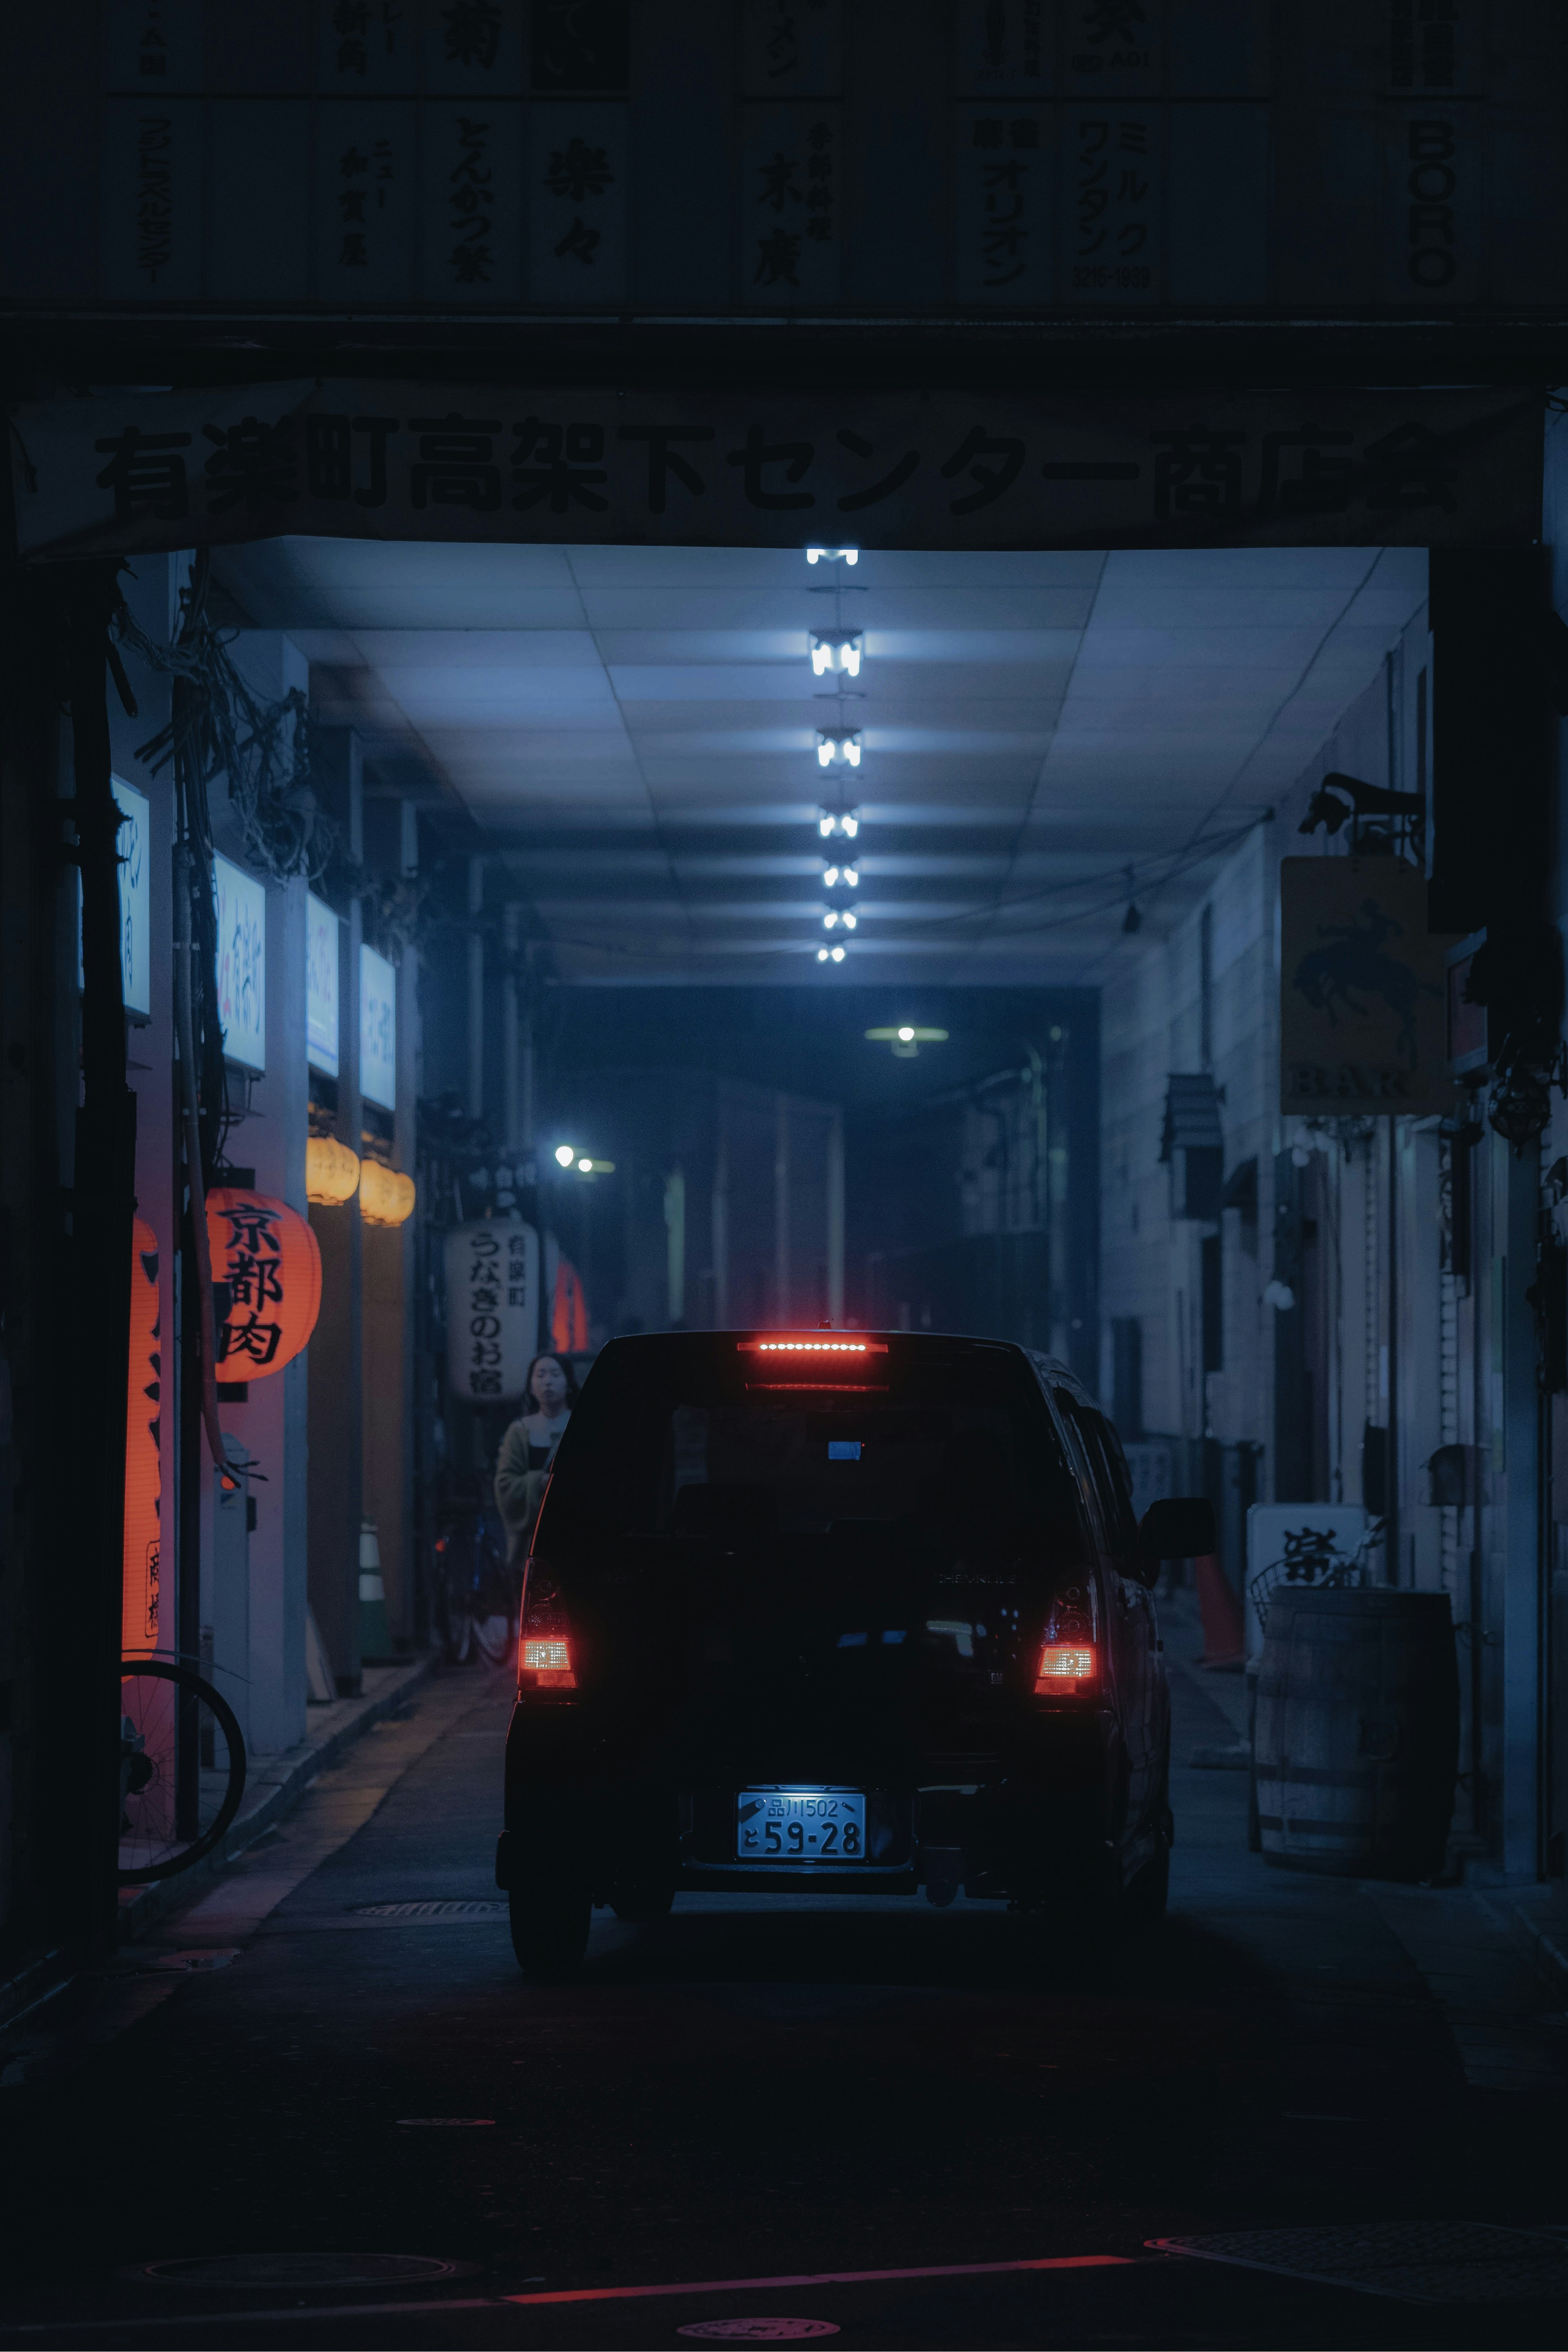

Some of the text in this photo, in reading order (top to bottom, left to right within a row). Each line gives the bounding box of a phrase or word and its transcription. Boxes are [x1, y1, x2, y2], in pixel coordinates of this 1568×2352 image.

[382, 0, 403, 54] レー
[1110, 51, 1149, 67] AOI
[373, 140, 394, 208] ニュー
[806, 122, 833, 241] 季節料理
[973, 118, 1039, 149] 麻雀
[1077, 121, 1108, 256] ワンタン
[1117, 122, 1148, 256] ミルク
[137, 118, 172, 283] フジトラベルセンター
[338, 147, 368, 266] 加賀屋
[543, 138, 615, 265] 楽々
[982, 160, 1028, 286] オリオン
[1408, 120, 1456, 287] BORO
[96, 413, 1459, 523] 有楽町高架下センター商店会
[1288, 1064, 1409, 1098] BAR
[217, 1203, 283, 1365] 京都肉
[470, 1232, 503, 1393] うなぎのお宿
[509, 1235, 526, 1308] 有楽町
[991, 1672, 1002, 1682] GM
[765, 1820, 861, 1855] 59-28
